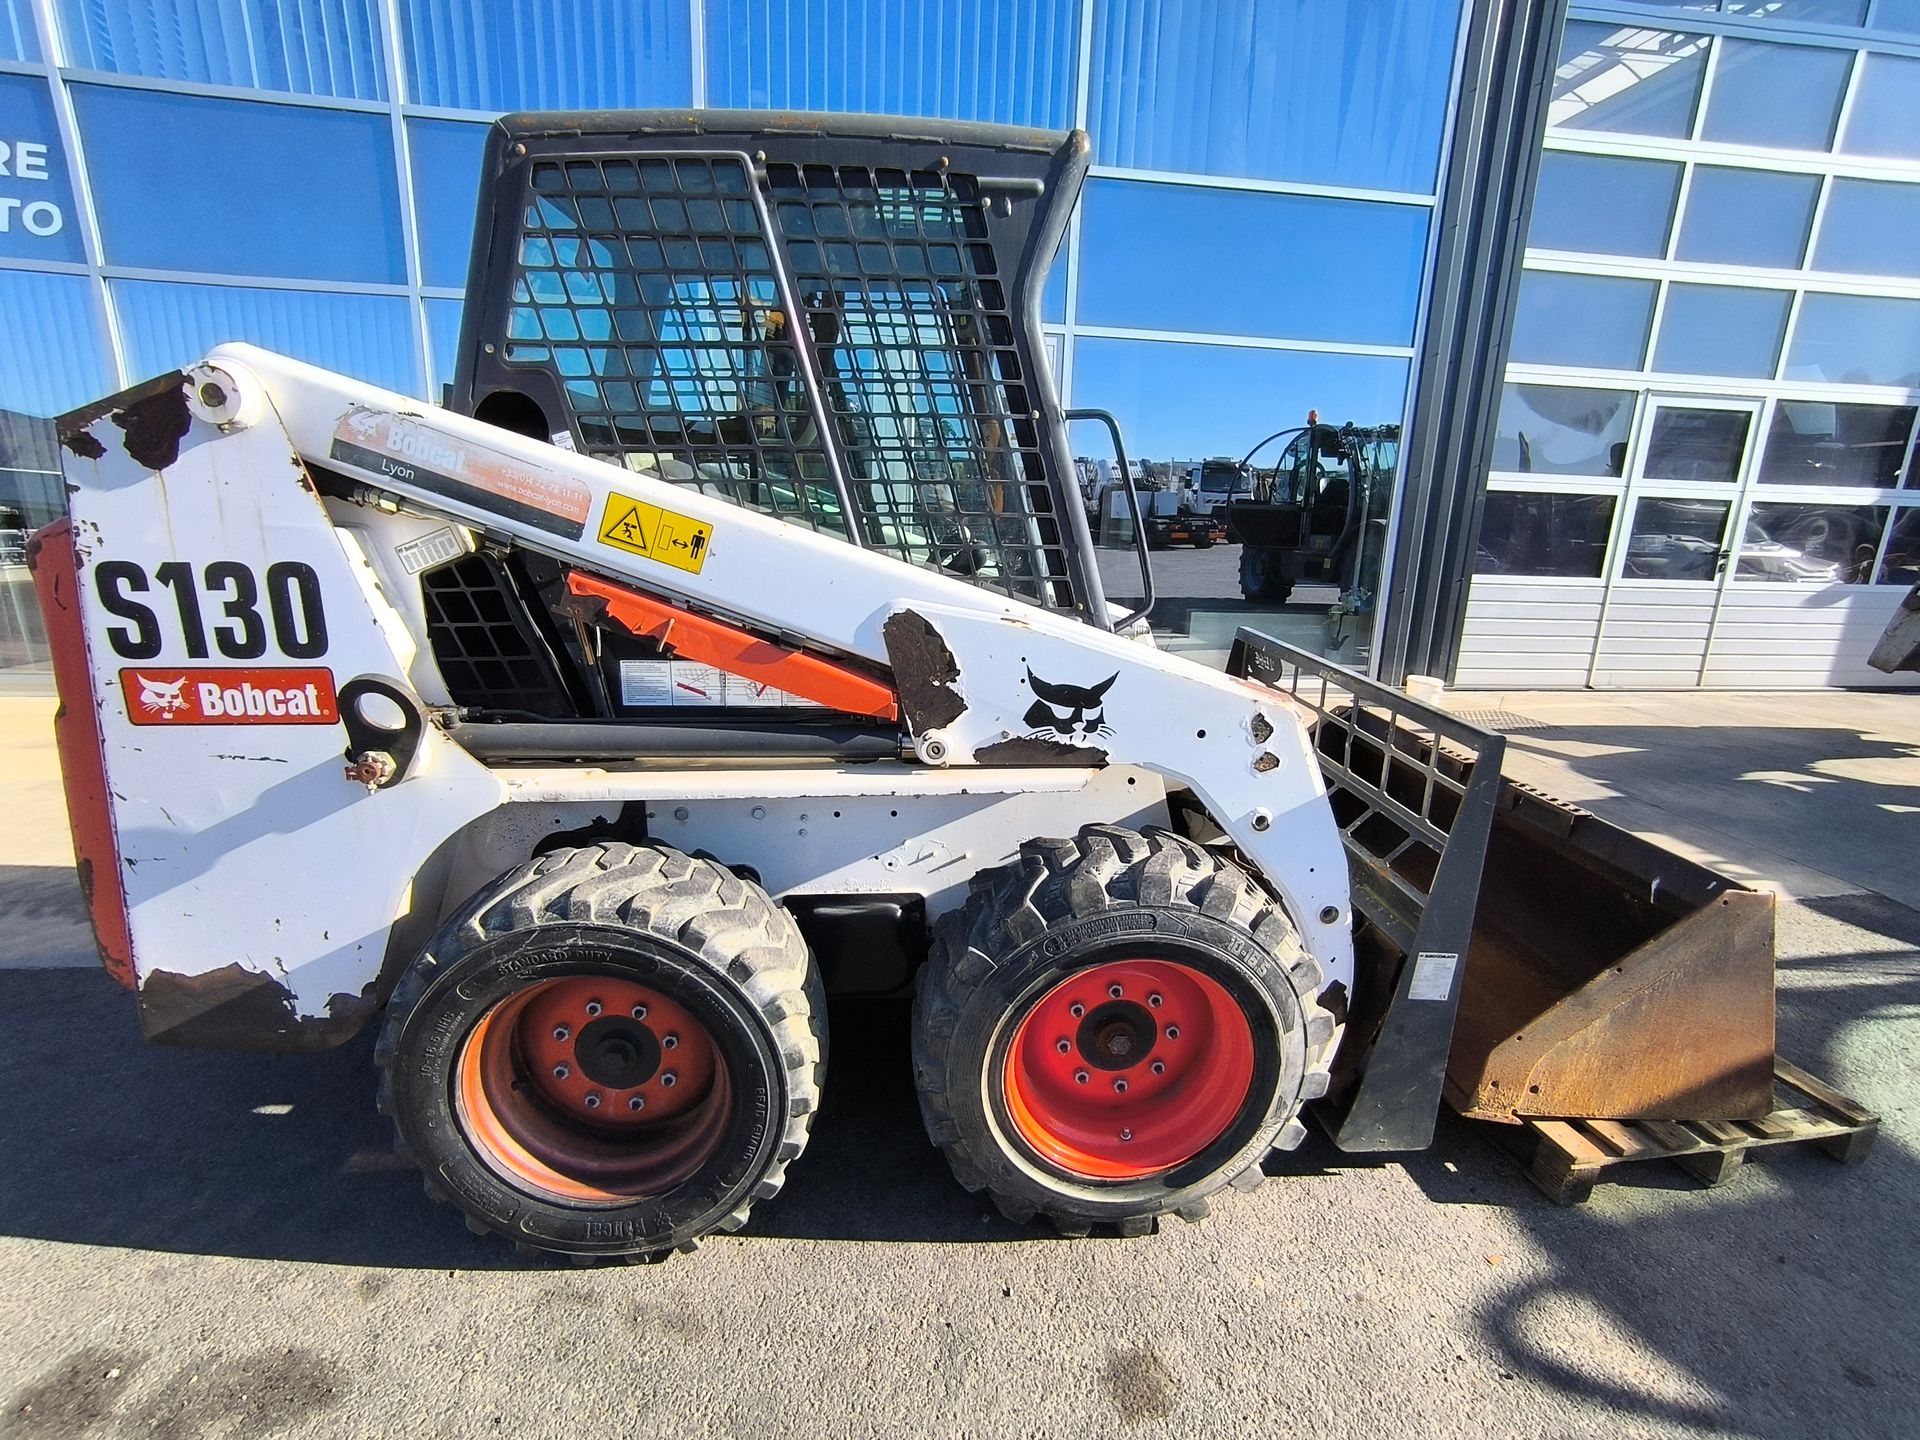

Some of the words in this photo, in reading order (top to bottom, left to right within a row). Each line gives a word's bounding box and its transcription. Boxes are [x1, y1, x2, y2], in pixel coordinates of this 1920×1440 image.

[0, 197, 63, 236] TO
[381, 458, 415, 480] Lyon
[95, 561, 329, 659] S130
[197, 682, 321, 716] Bobcat
